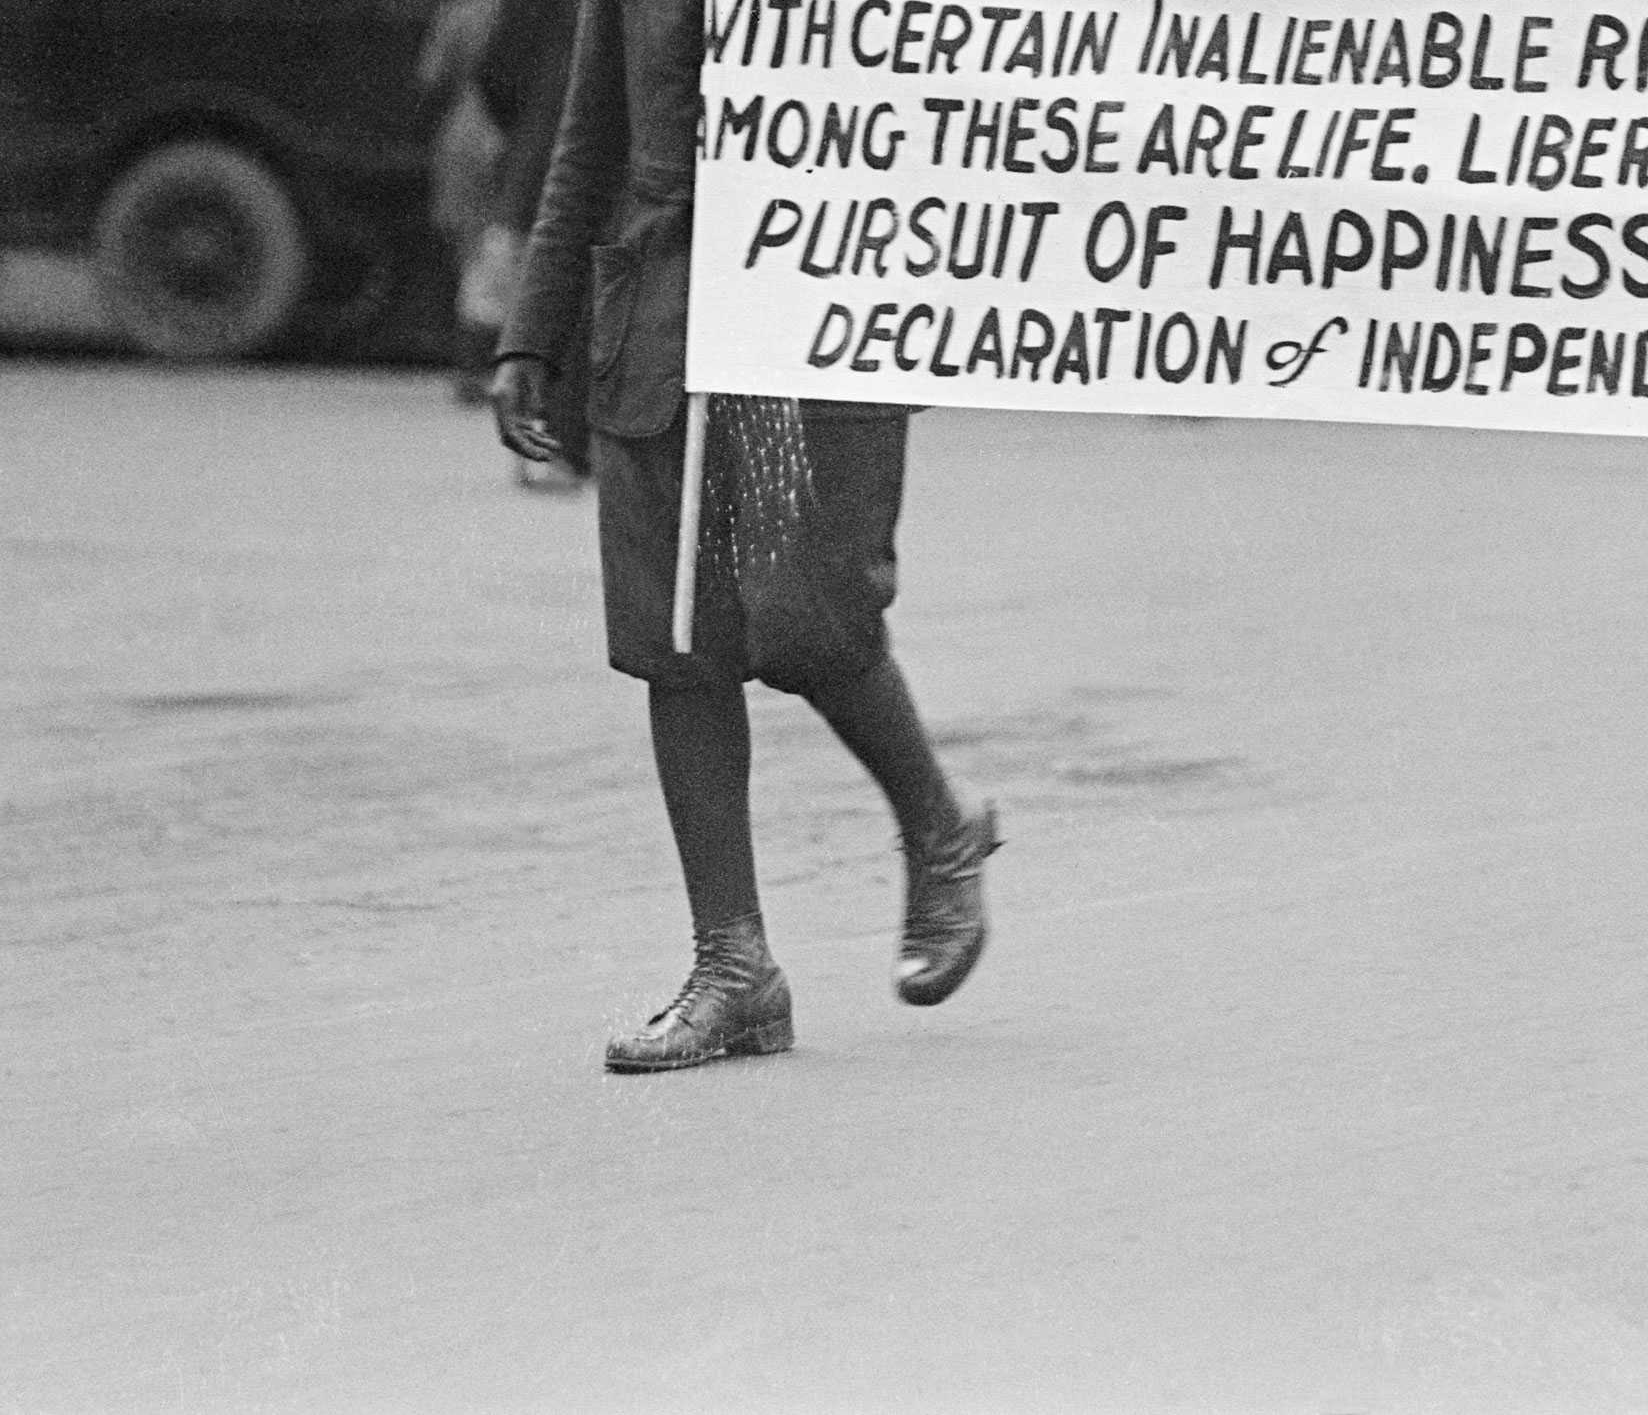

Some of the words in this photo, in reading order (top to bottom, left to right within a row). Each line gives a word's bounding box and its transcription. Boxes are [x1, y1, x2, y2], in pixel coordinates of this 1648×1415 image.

[923, 97, 1124, 174] THESE
[1136, 103, 1274, 181] ARE
[744, 196, 1060, 282] PURSUIT
[1084, 200, 1188, 290] OF
[807, 303, 1248, 385] DECLARATION
[1265, 316, 1349, 387] of
